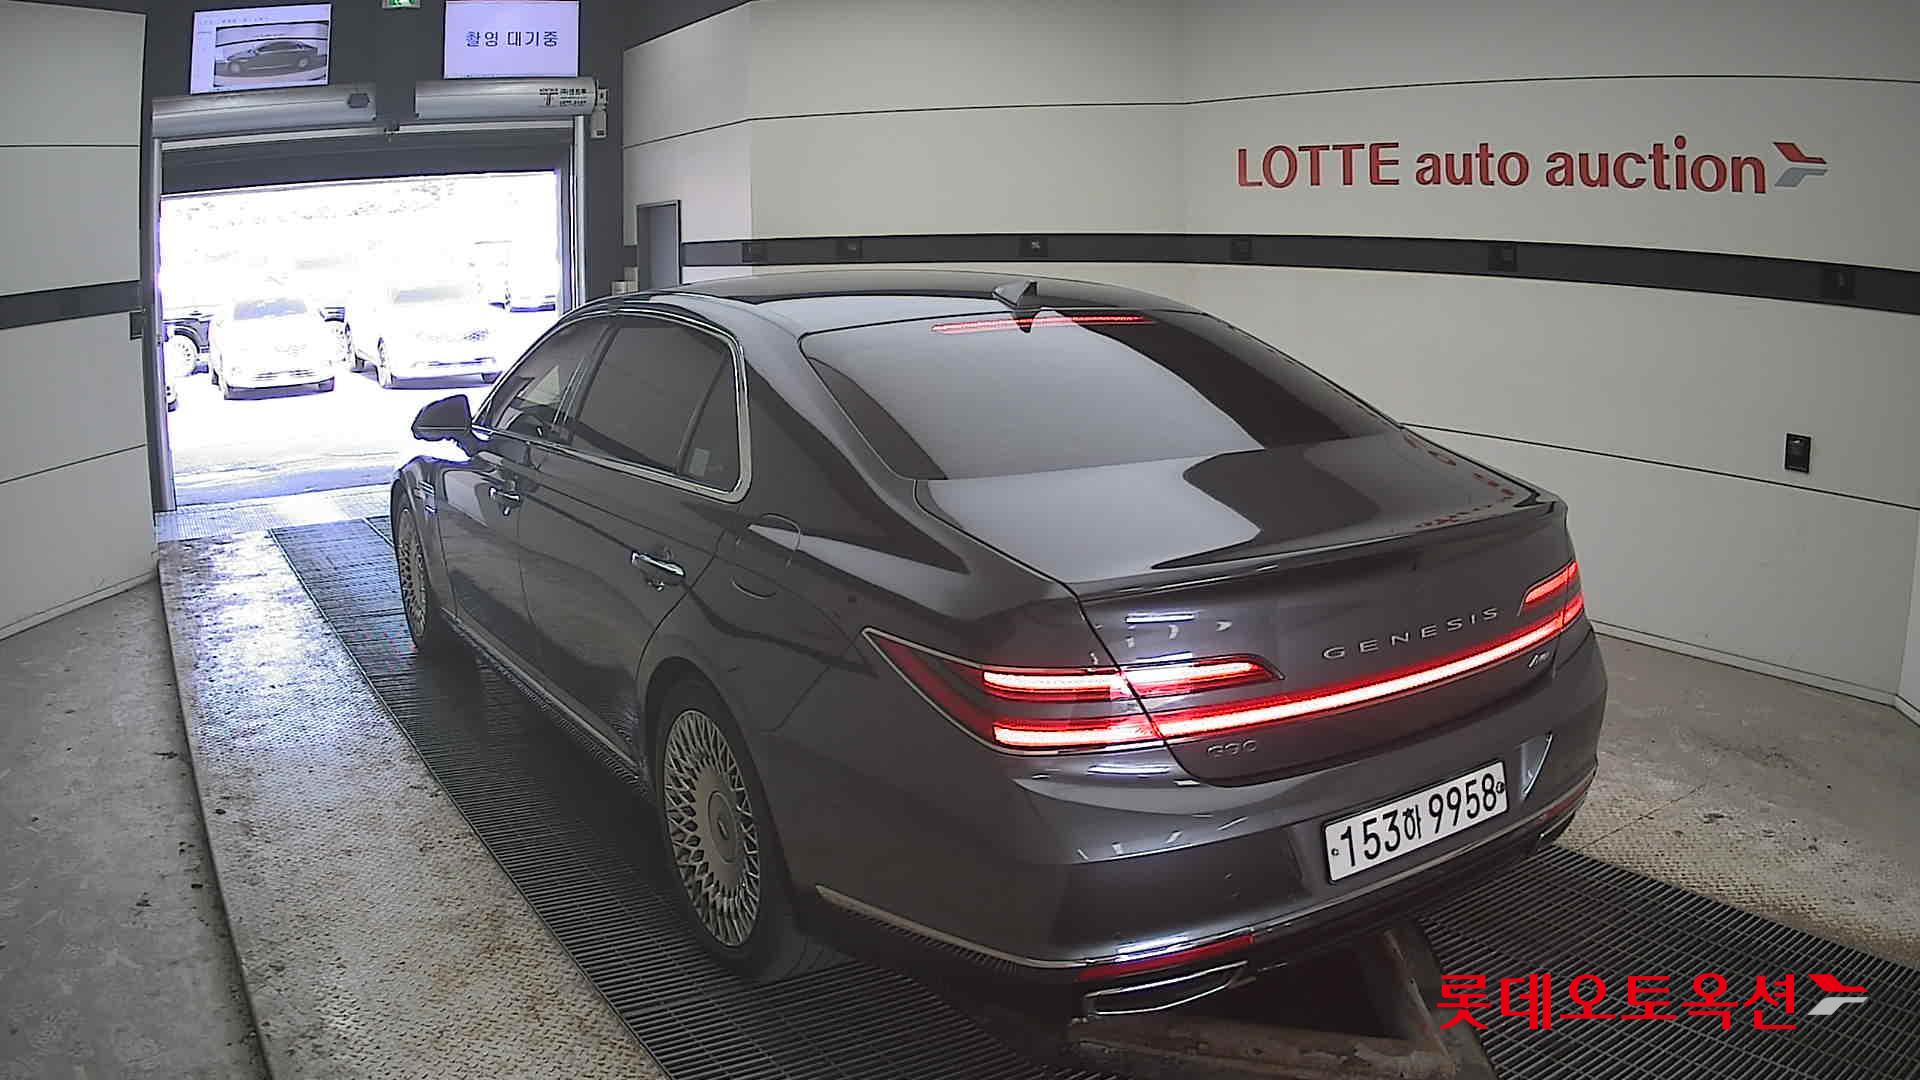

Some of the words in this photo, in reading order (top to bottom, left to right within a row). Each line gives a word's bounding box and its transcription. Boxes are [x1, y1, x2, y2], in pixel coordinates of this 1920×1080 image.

[465, 31, 498, 47] 촬영
[507, 31, 559, 47] 대기중
[1236, 142, 1400, 188] LOTTE
[1415, 142, 1530, 187] auto
[1545, 135, 1767, 194] auction
[1323, 607, 1498, 659] GENESIS
[1340, 804, 1421, 867] 153하
[1428, 773, 1498, 834] 9958
